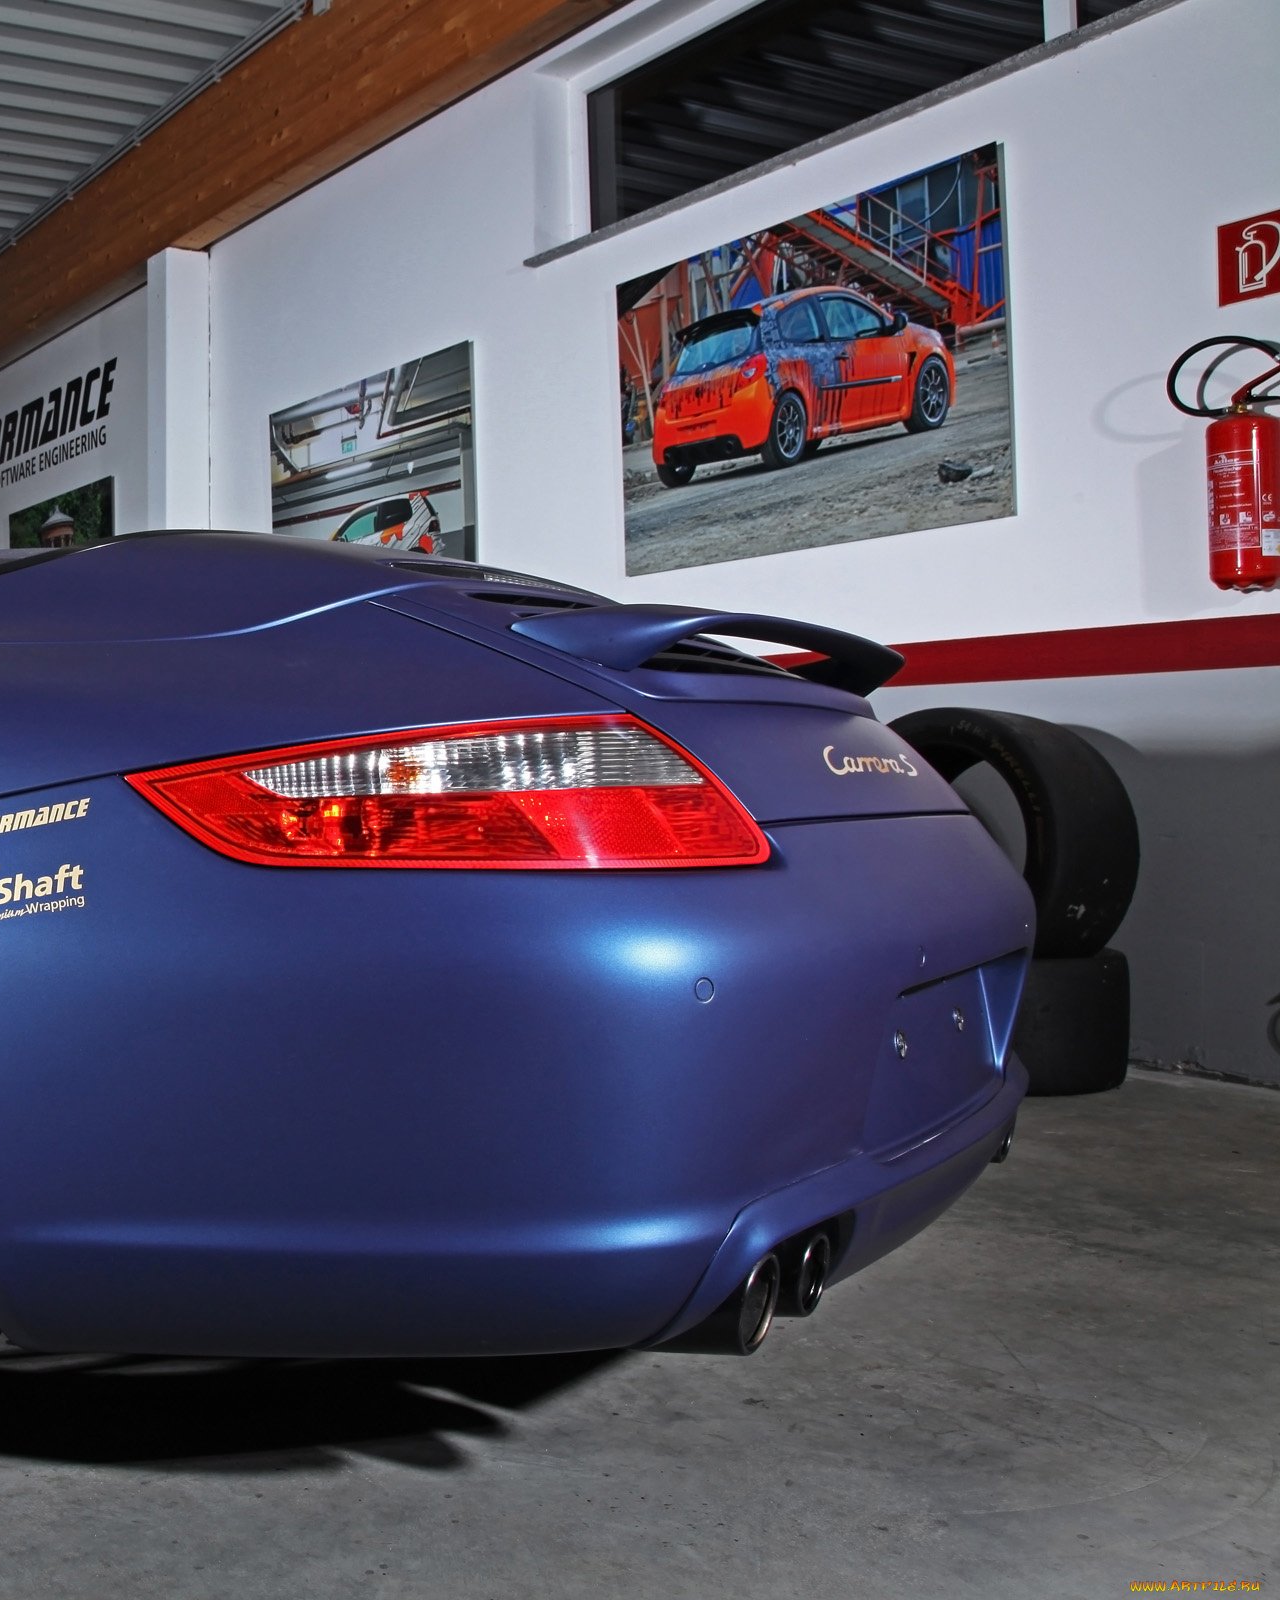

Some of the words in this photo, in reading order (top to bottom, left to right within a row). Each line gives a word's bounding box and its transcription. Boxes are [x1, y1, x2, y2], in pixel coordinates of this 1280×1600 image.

[39, 425, 107, 472] ENGINEERING
[823, 745, 904, 775] Carrera
[898, 753, 918, 777] S
